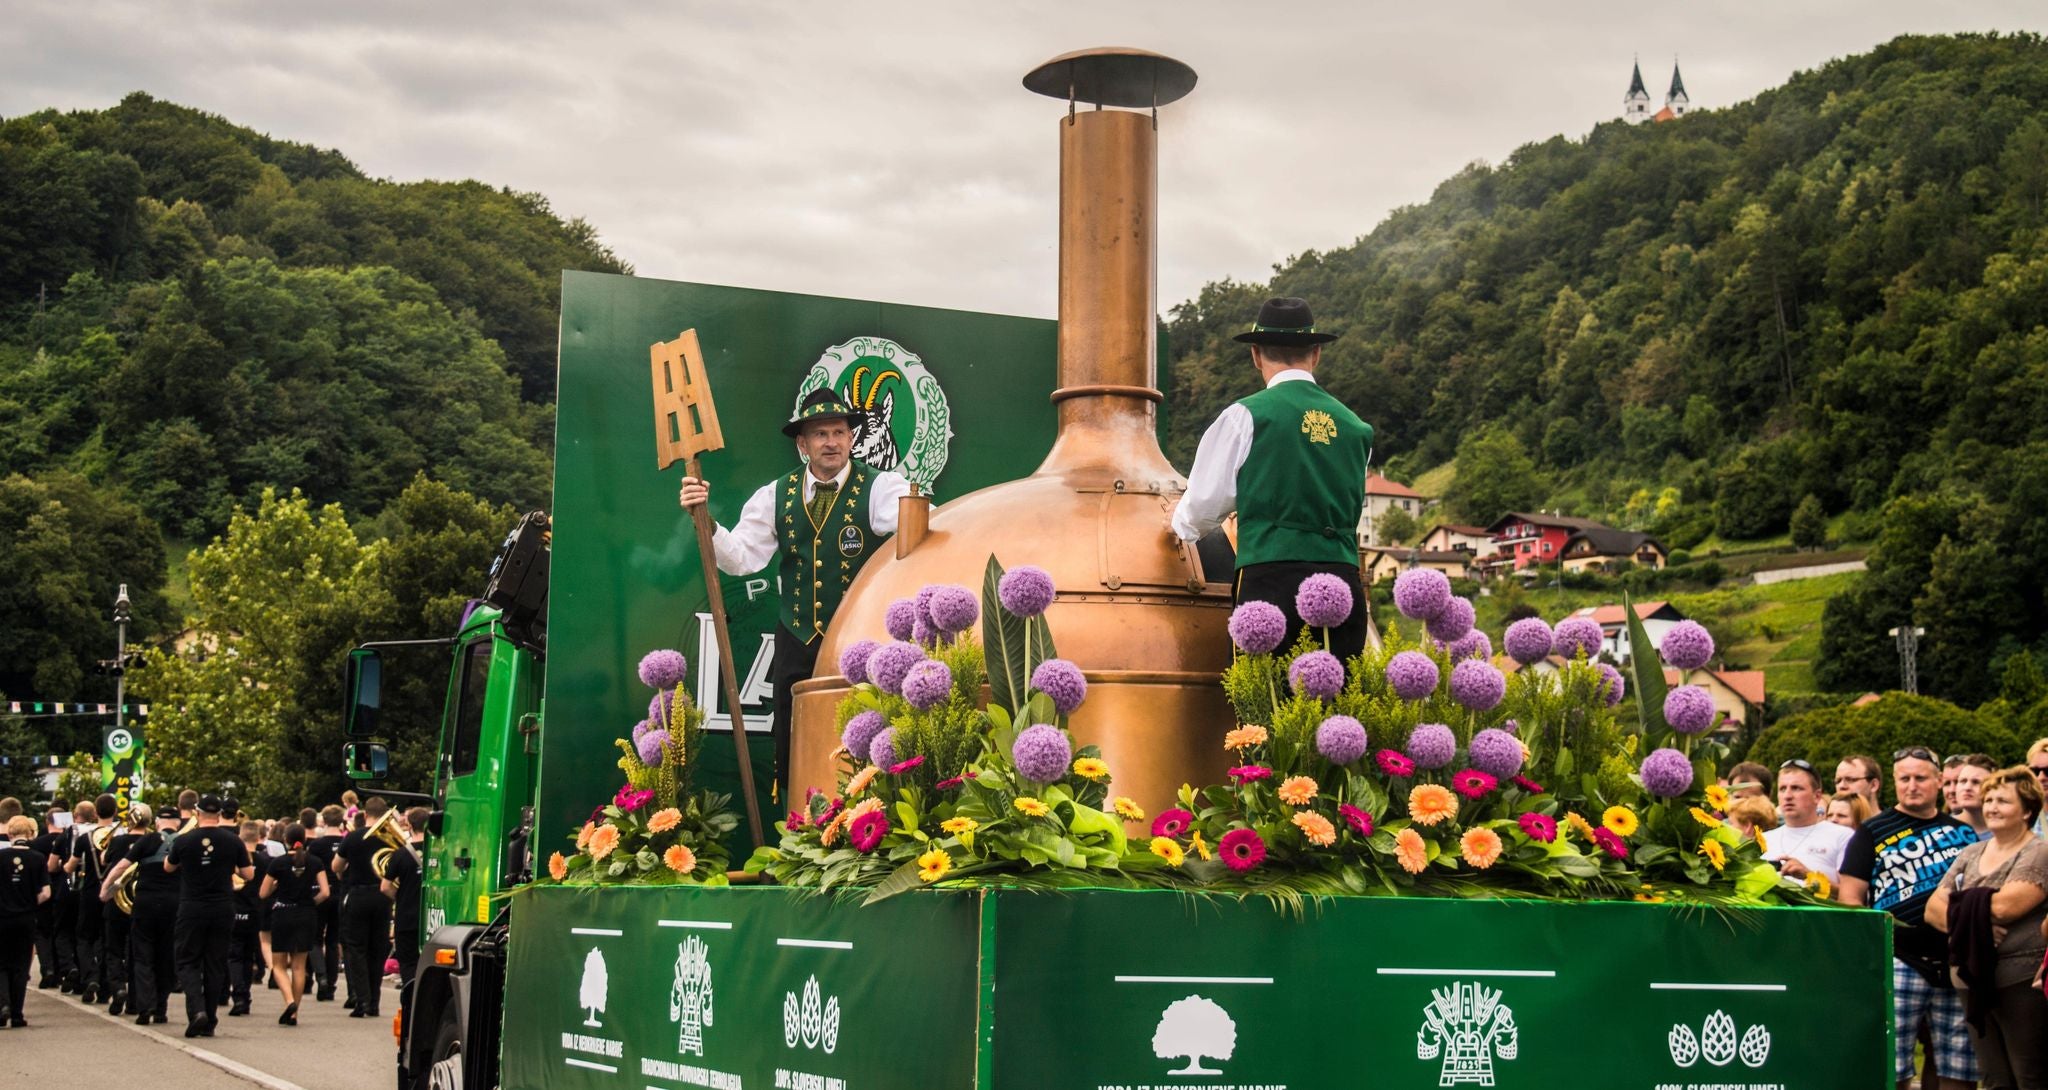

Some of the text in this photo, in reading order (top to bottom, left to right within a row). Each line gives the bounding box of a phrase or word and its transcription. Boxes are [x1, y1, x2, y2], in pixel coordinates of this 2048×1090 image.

[1457, 1060, 1479, 1069] 1825
[775, 1068, 791, 1089] 100%
[792, 1071, 825, 1090] SLOVENSKI
